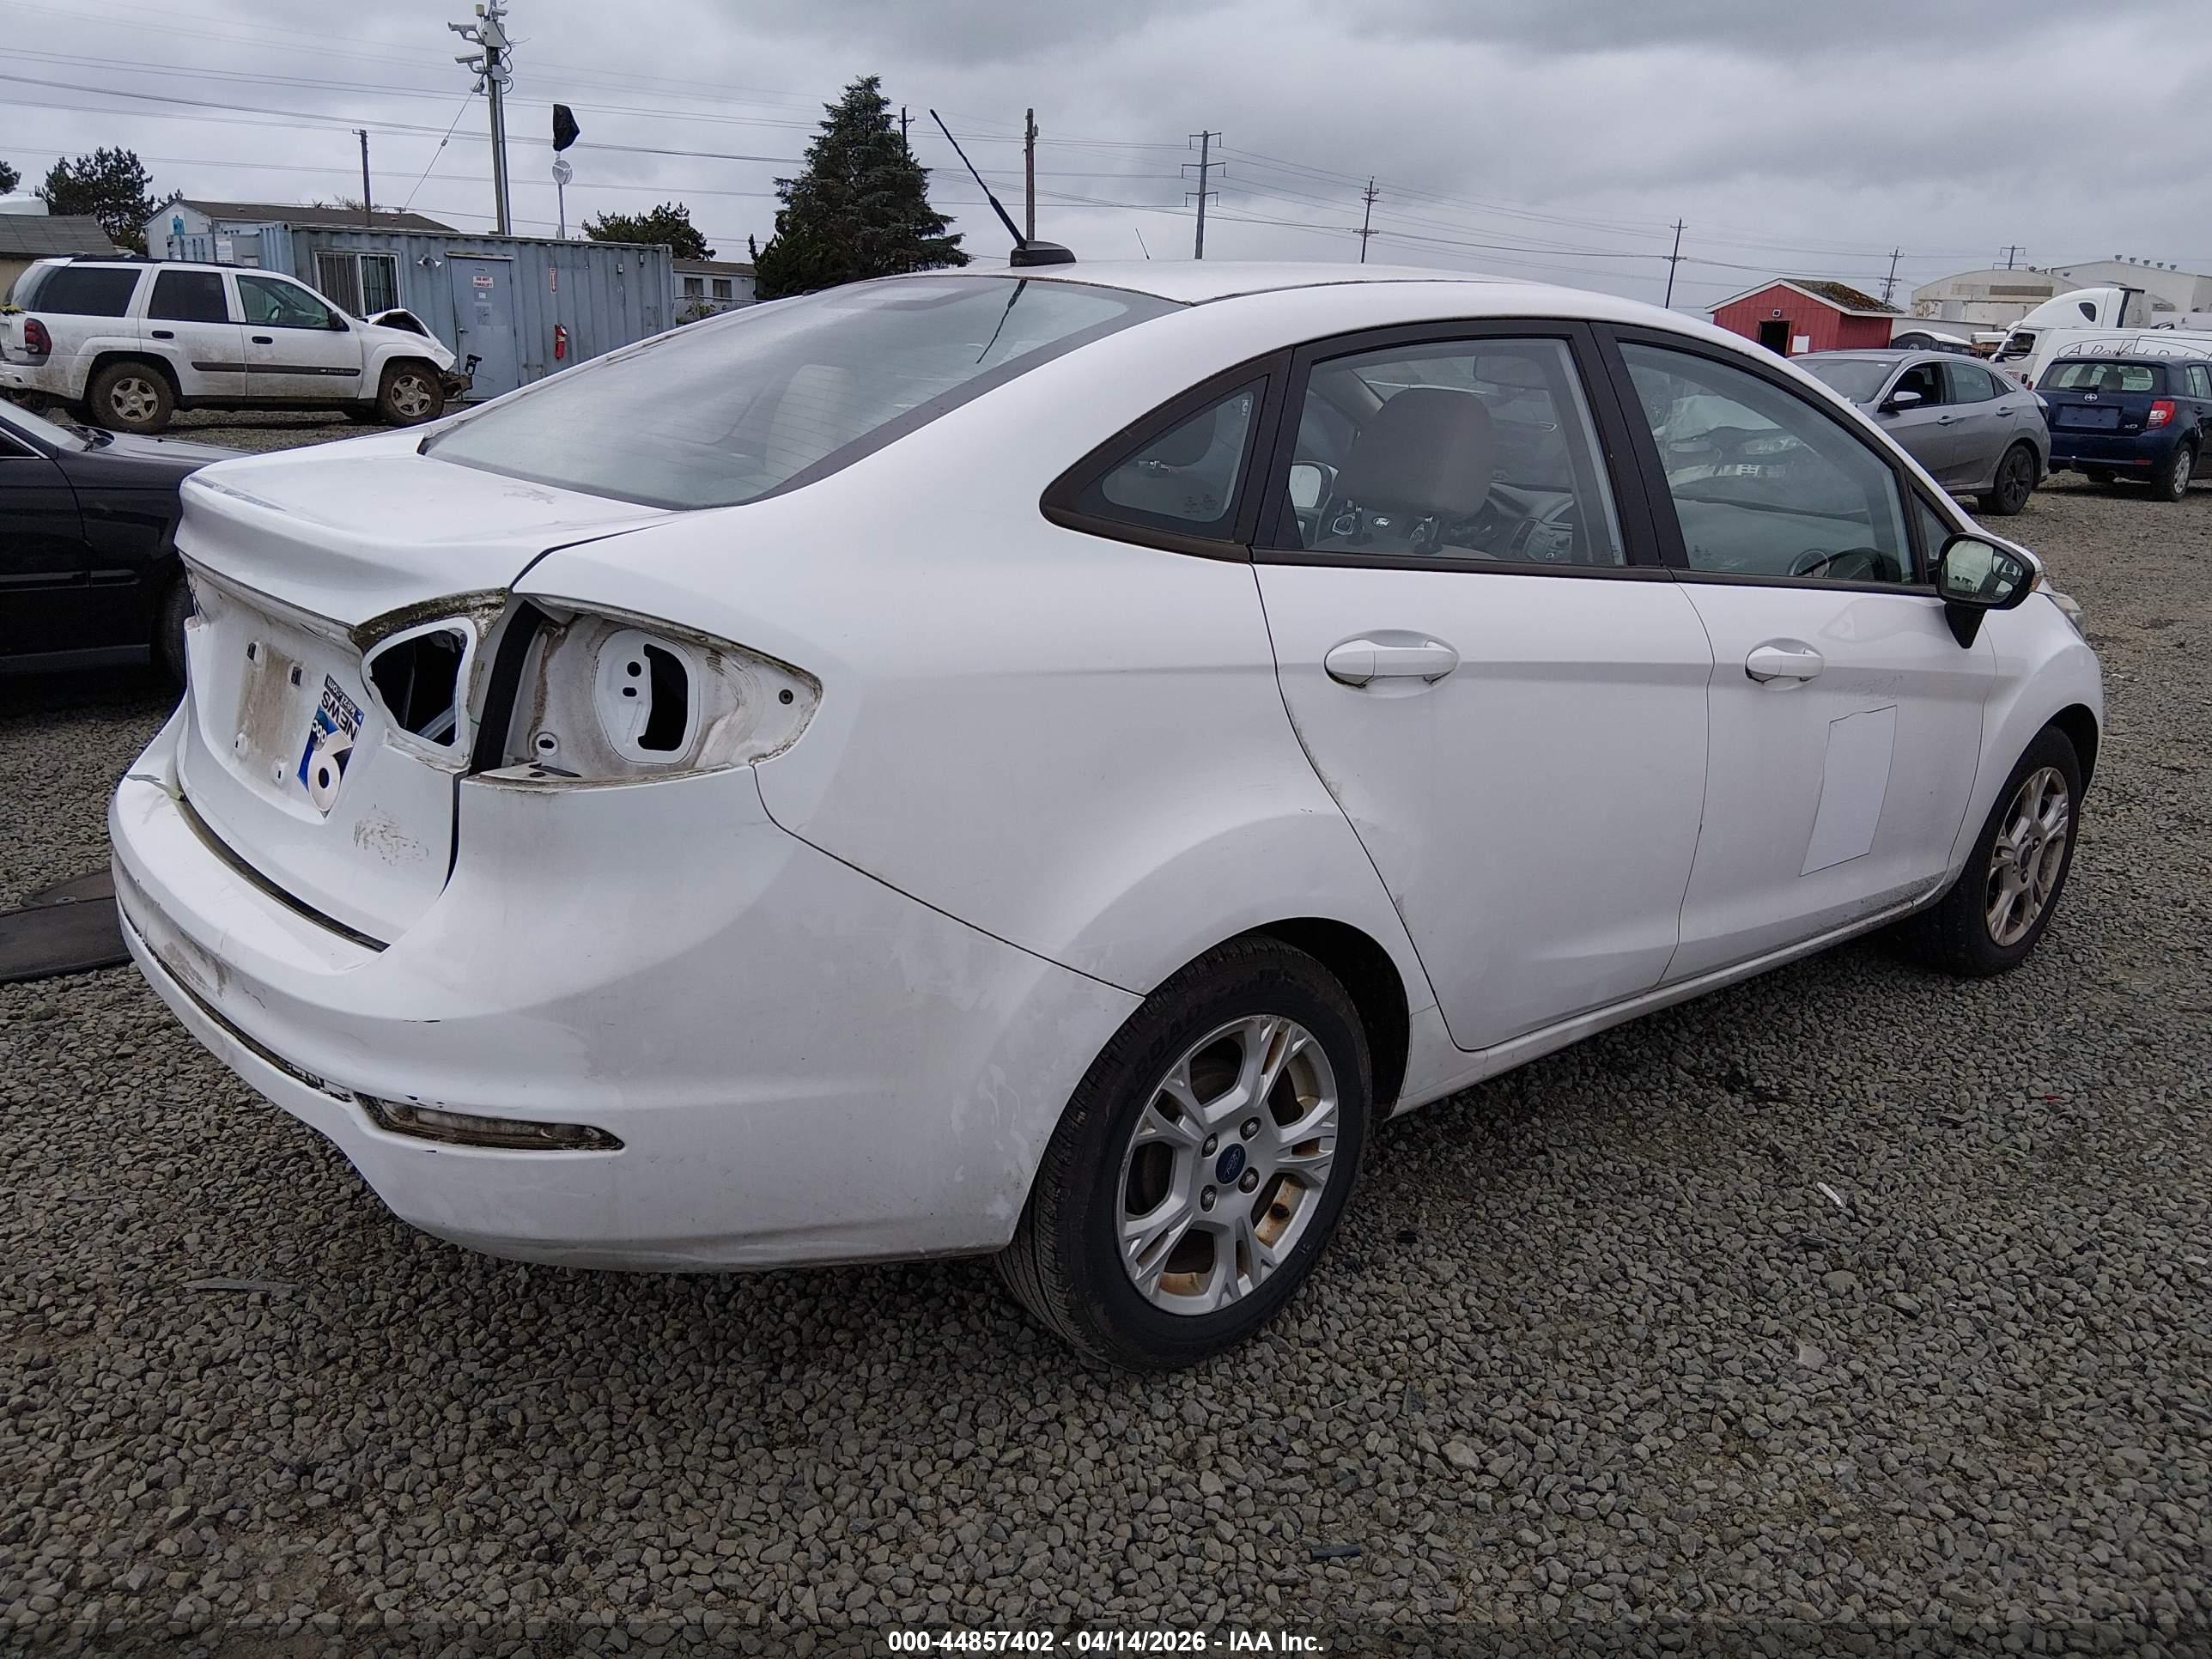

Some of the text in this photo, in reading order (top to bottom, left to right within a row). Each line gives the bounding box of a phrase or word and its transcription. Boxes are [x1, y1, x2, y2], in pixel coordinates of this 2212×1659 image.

[321, 690, 357, 742] NEWS
[327, 678, 356, 717] kezi.com
[313, 720, 328, 744] abc
